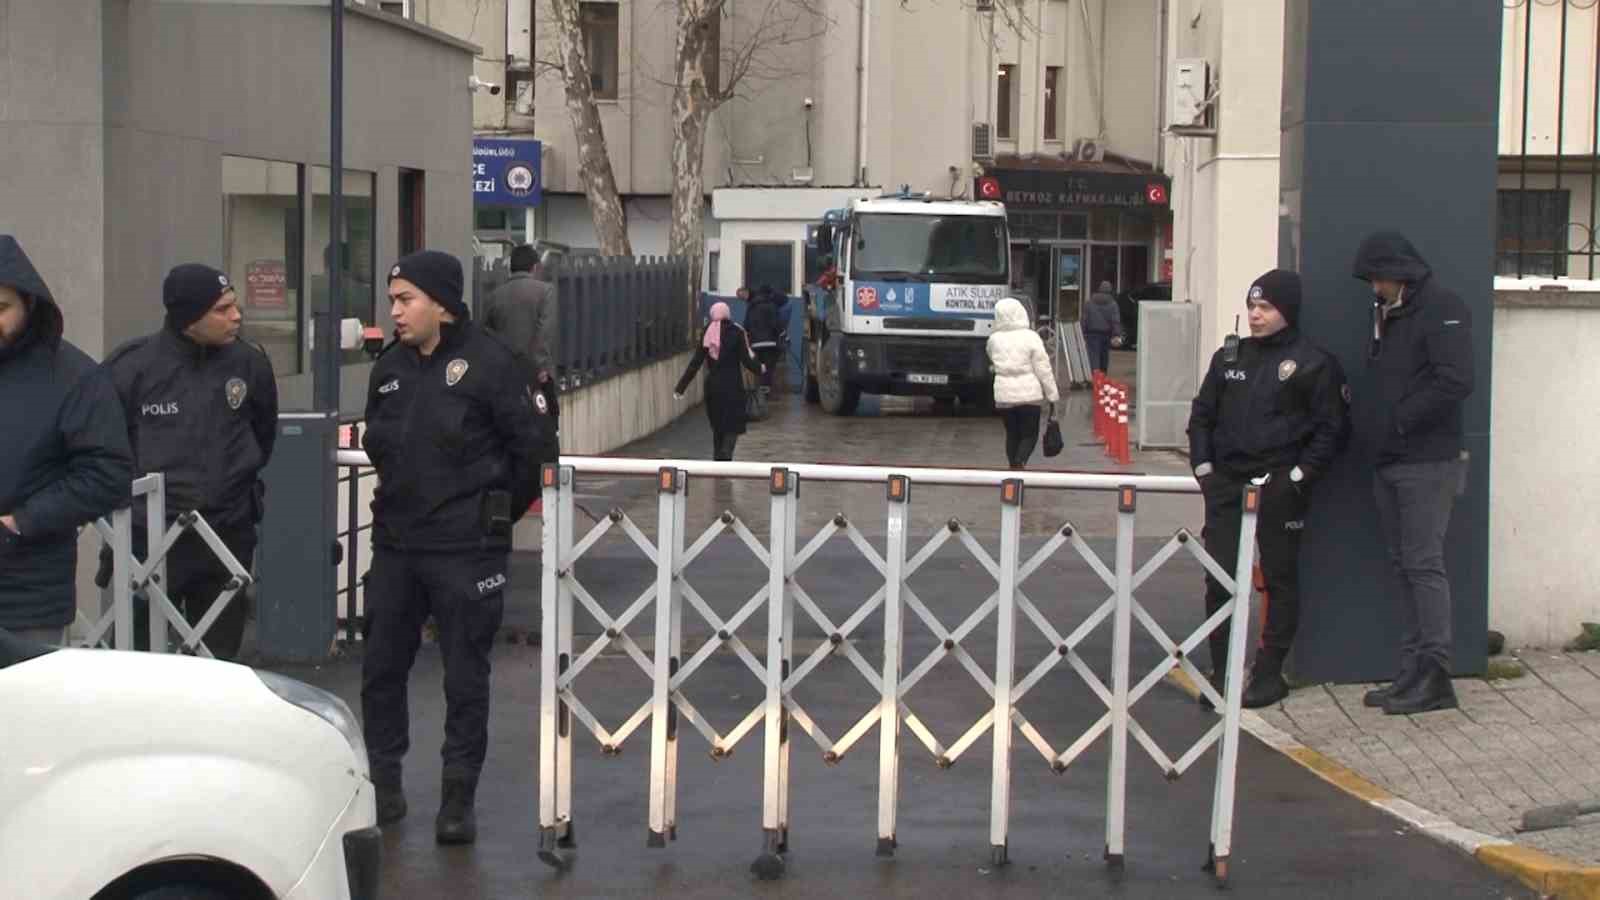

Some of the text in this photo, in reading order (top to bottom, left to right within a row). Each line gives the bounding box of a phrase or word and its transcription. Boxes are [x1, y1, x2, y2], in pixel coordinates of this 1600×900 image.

[473, 177, 495, 192] EZİ
[946, 287, 1001, 298] ATIK SULAR
[945, 299, 976, 310] KONTROL
[141, 402, 179, 416] POLIS
